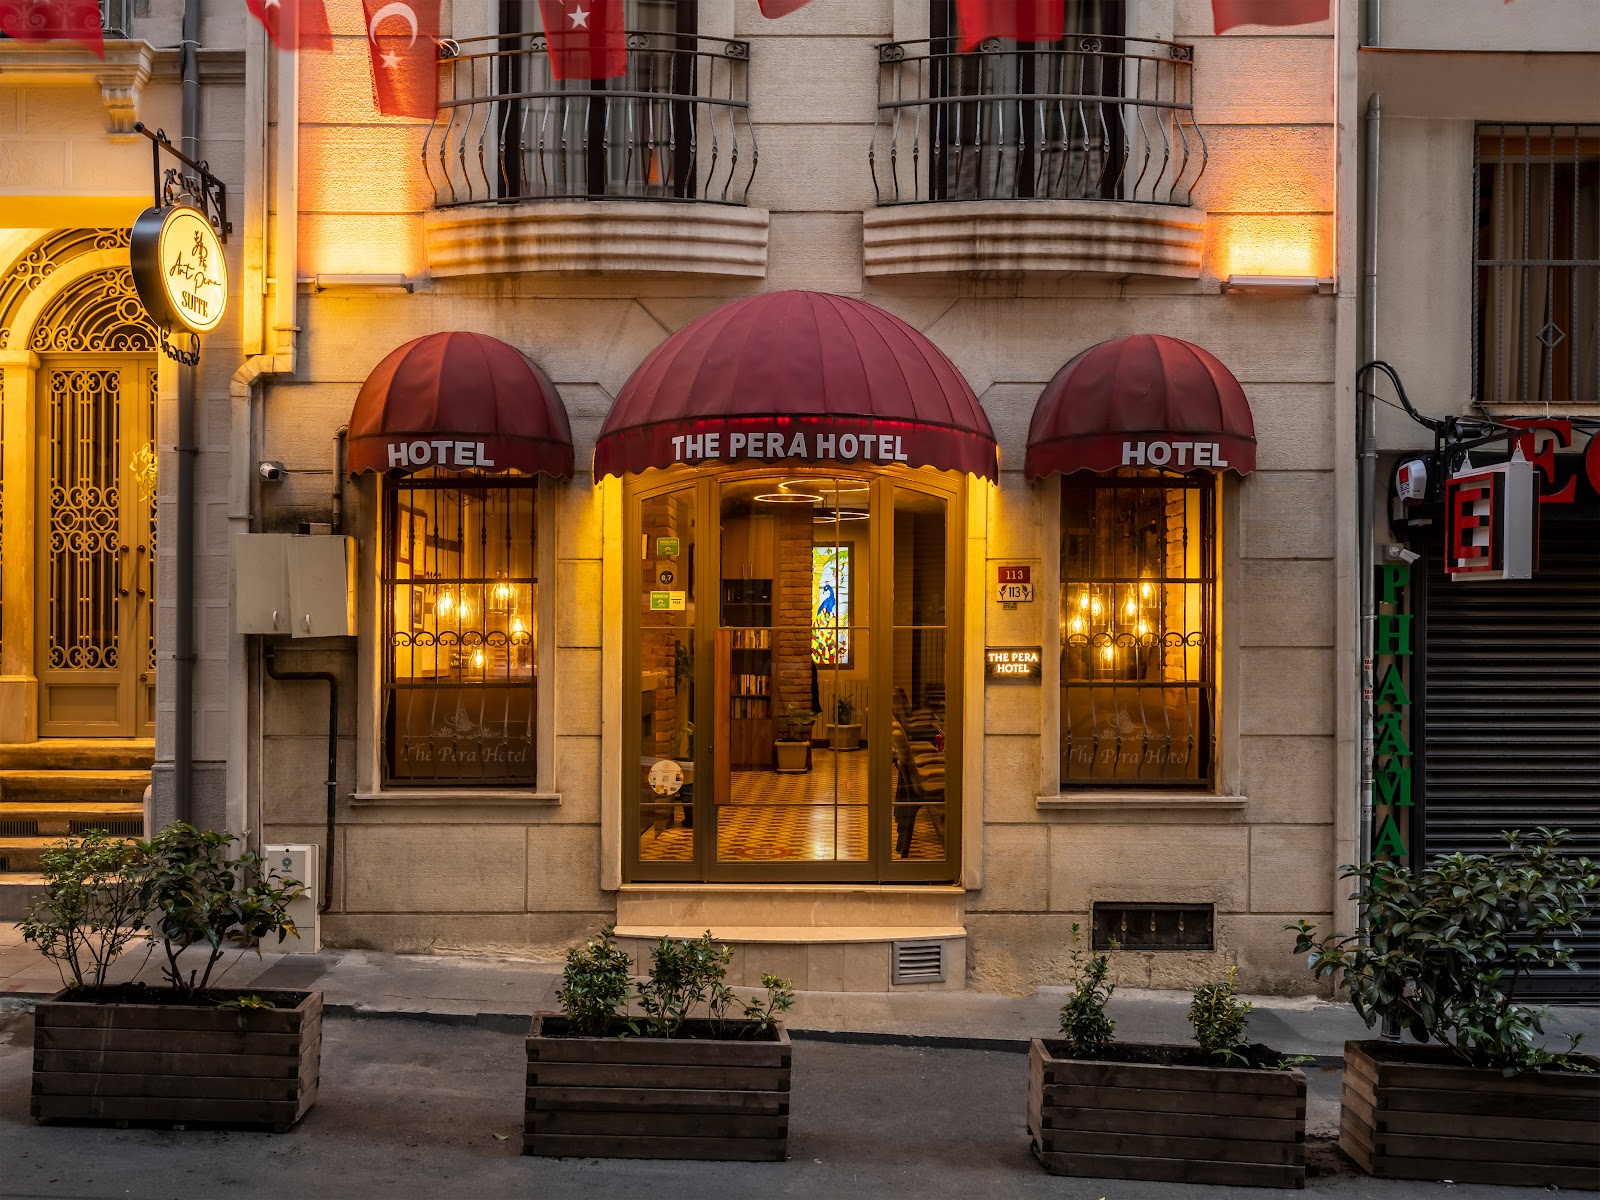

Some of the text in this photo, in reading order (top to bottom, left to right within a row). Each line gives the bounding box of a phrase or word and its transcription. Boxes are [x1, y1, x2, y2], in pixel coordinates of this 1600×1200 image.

[181, 291, 208, 318] SUITE
[387, 440, 495, 468] HOTEL
[671, 432, 908, 462] THE PERA HOTEL
[1121, 441, 1228, 467] HOTEL
[1453, 488, 1482, 560] E
[1005, 570, 1024, 580] 113
[1008, 586, 1021, 598] 113
[988, 653, 1038, 662] THE PERA
[997, 663, 1030, 673] HOTEL
